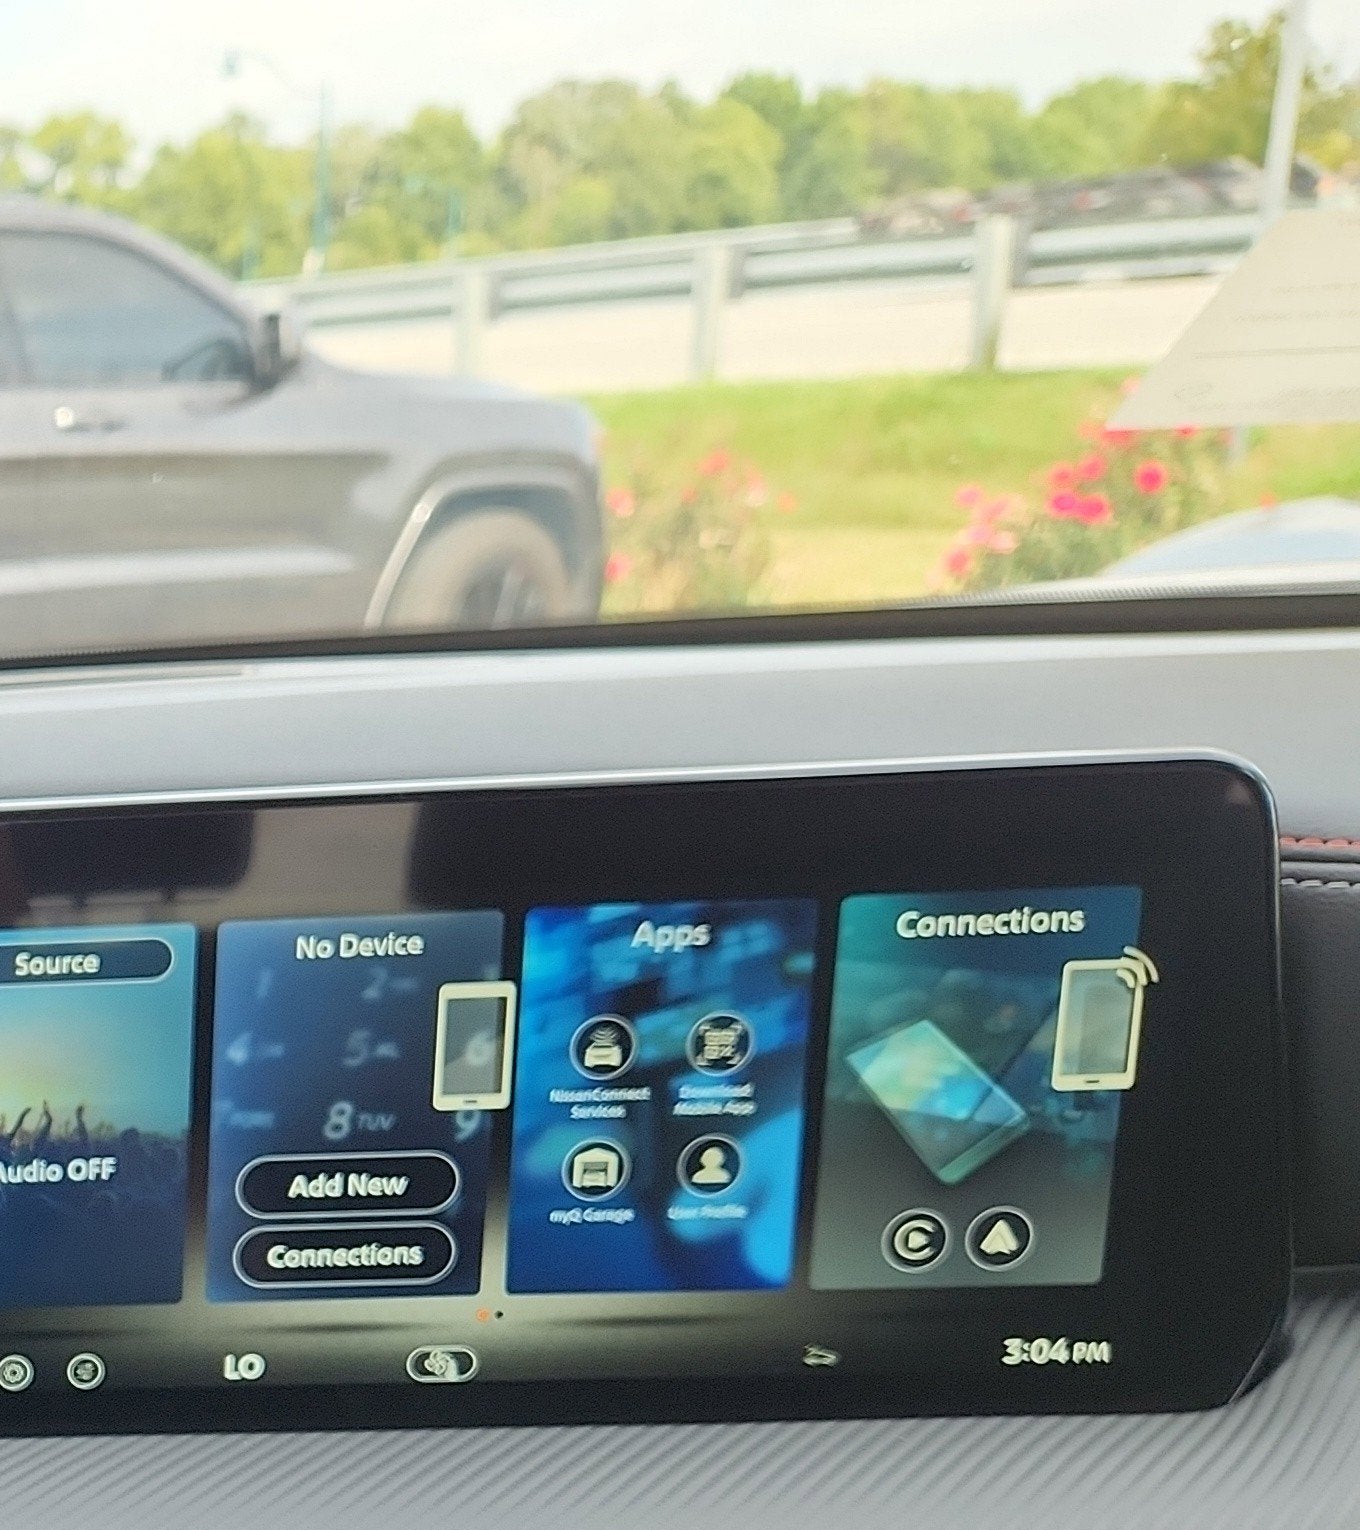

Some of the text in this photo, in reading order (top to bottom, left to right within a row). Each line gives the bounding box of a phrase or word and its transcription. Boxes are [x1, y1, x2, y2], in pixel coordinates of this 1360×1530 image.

[896, 906, 1085, 939] Connections
[295, 932, 425, 959] No Device
[631, 920, 712, 953] Apps
[15, 952, 101, 976] Source
[67, 1157, 117, 1181] OFF
[288, 1173, 410, 1198] Add New
[267, 1243, 424, 1269] Connections
[1001, 1337, 1112, 1365] 3:04 PM
[224, 1352, 266, 1380] LO
